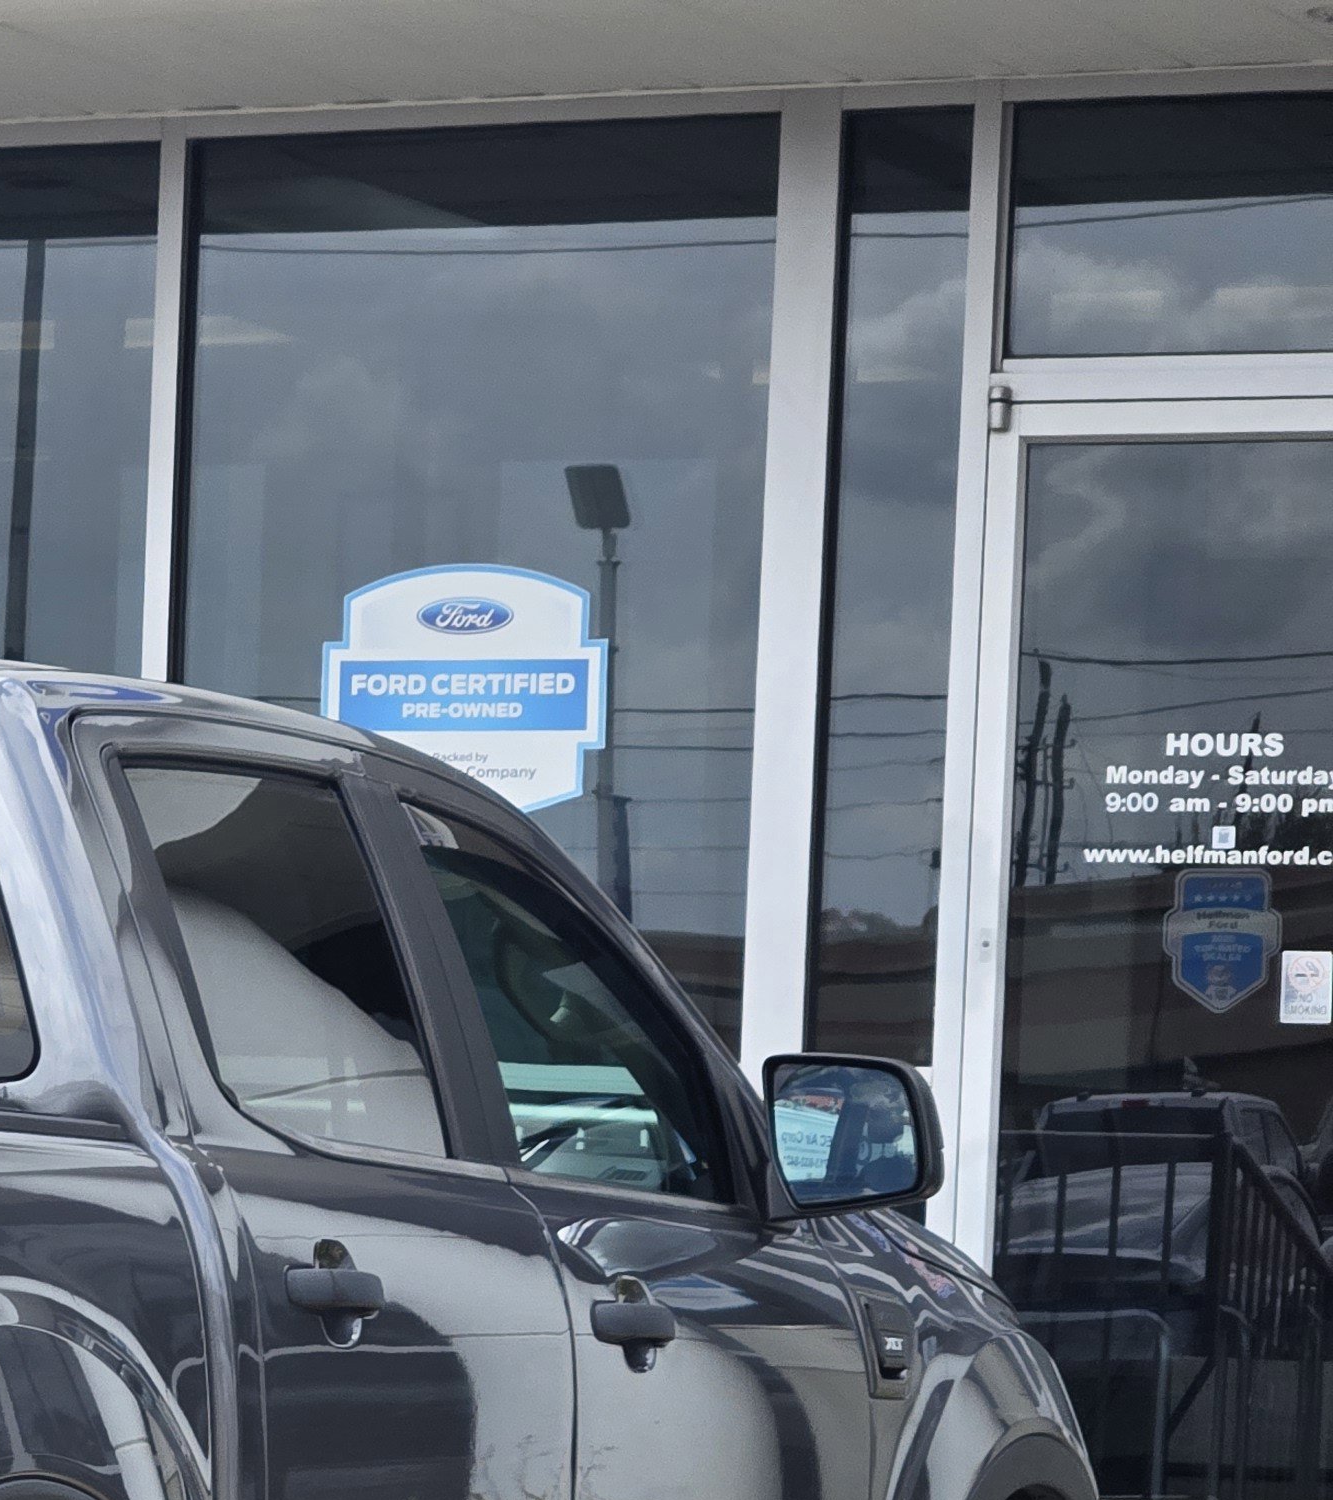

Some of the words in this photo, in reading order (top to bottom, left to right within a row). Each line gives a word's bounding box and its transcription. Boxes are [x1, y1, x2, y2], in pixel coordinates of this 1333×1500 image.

[434, 603, 493, 628] Ford
[350, 674, 427, 696] FORD
[431, 672, 576, 696] CERTIFIED
[401, 702, 523, 719] PRE-OWNED
[1165, 732, 1285, 757] HOURS
[475, 752, 489, 764] by
[466, 766, 537, 780] Company
[1105, 765, 1205, 789] Monday
[1105, 792, 1159, 813] 9:00
[1169, 796, 1210, 812] am
[1235, 793, 1293, 813] 9:00
[1083, 845, 1333, 866] www.helfmanford.c
